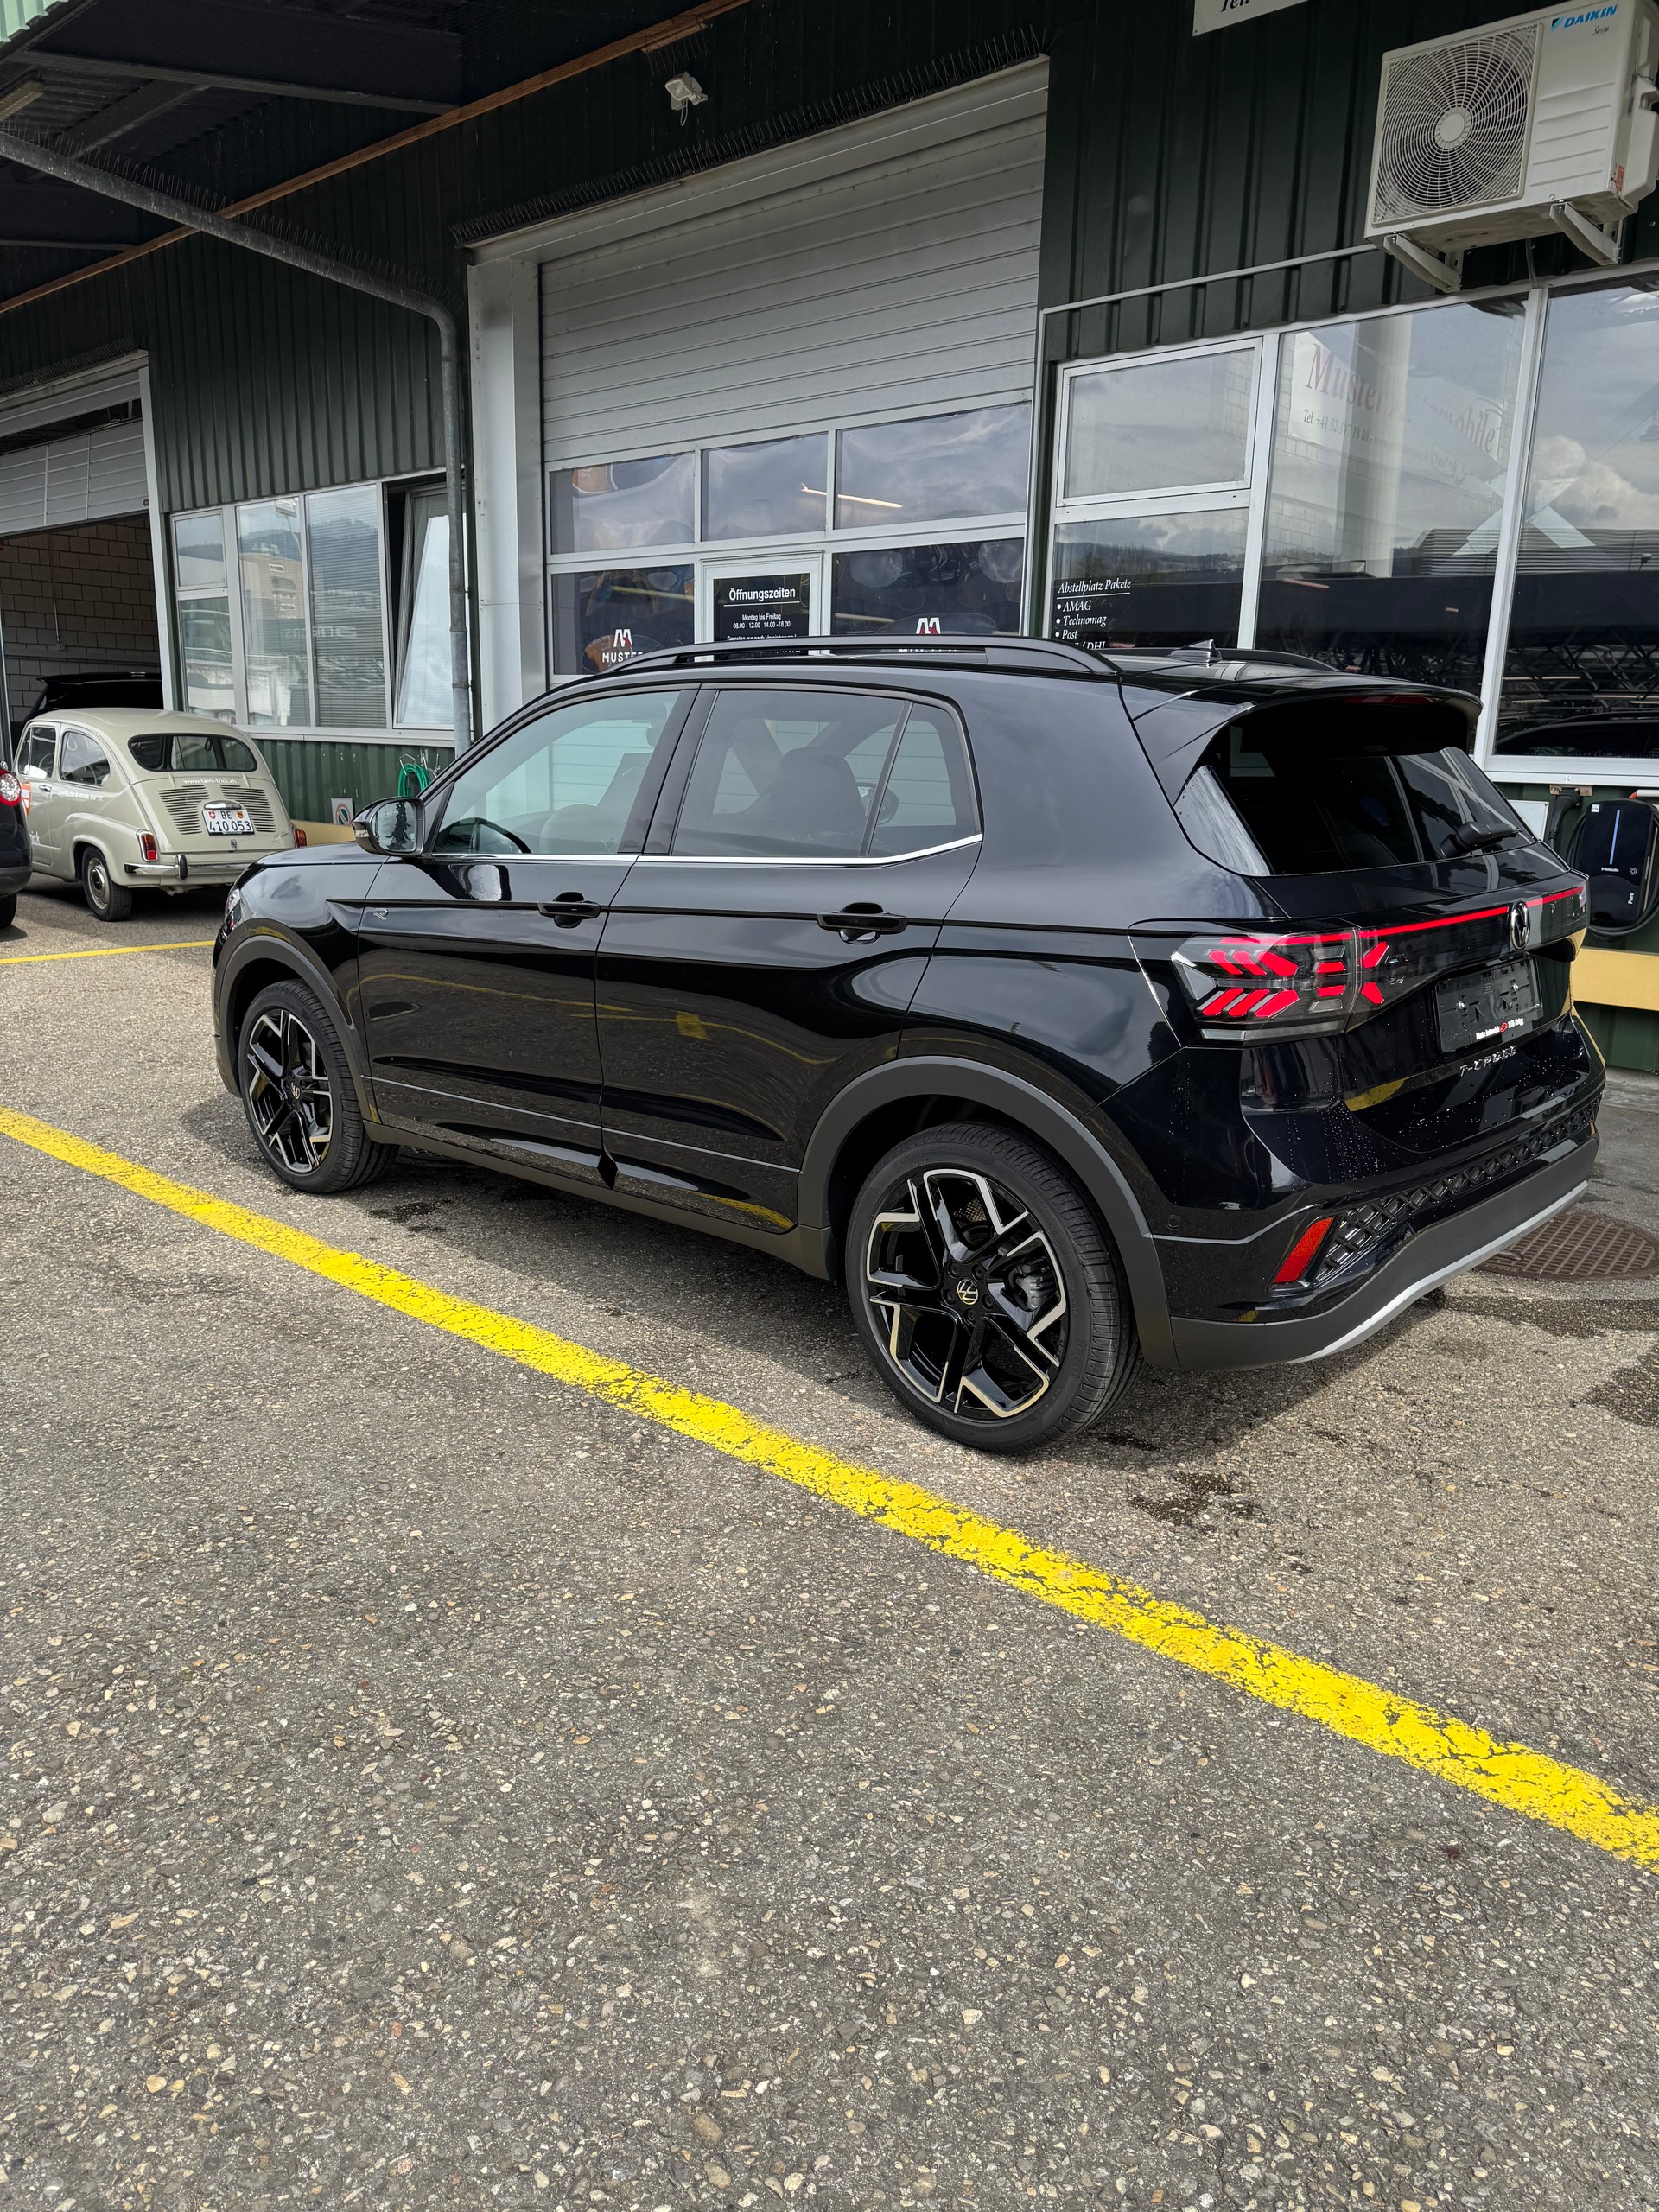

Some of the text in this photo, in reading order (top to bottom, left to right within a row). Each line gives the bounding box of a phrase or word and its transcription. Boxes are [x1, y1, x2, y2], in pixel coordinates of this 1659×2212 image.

[1564, 3, 1618, 28] DAIKIN
[1303, 409, 1314, 425] Tel.
[1316, 415, 1328, 430] +41
[1329, 418, 1338, 432] 32
[1058, 578, 1131, 595] Abstellplatz Pakete
[728, 587, 796, 601] Öffnungszeiten
[1062, 600, 1091, 612] AMAG
[766, 613, 781, 621] Freitag
[1063, 614, 1107, 627] Technomag
[1062, 629, 1078, 639] Post
[220, 810, 232, 820] BE
[209, 820, 251, 831] 410 053
